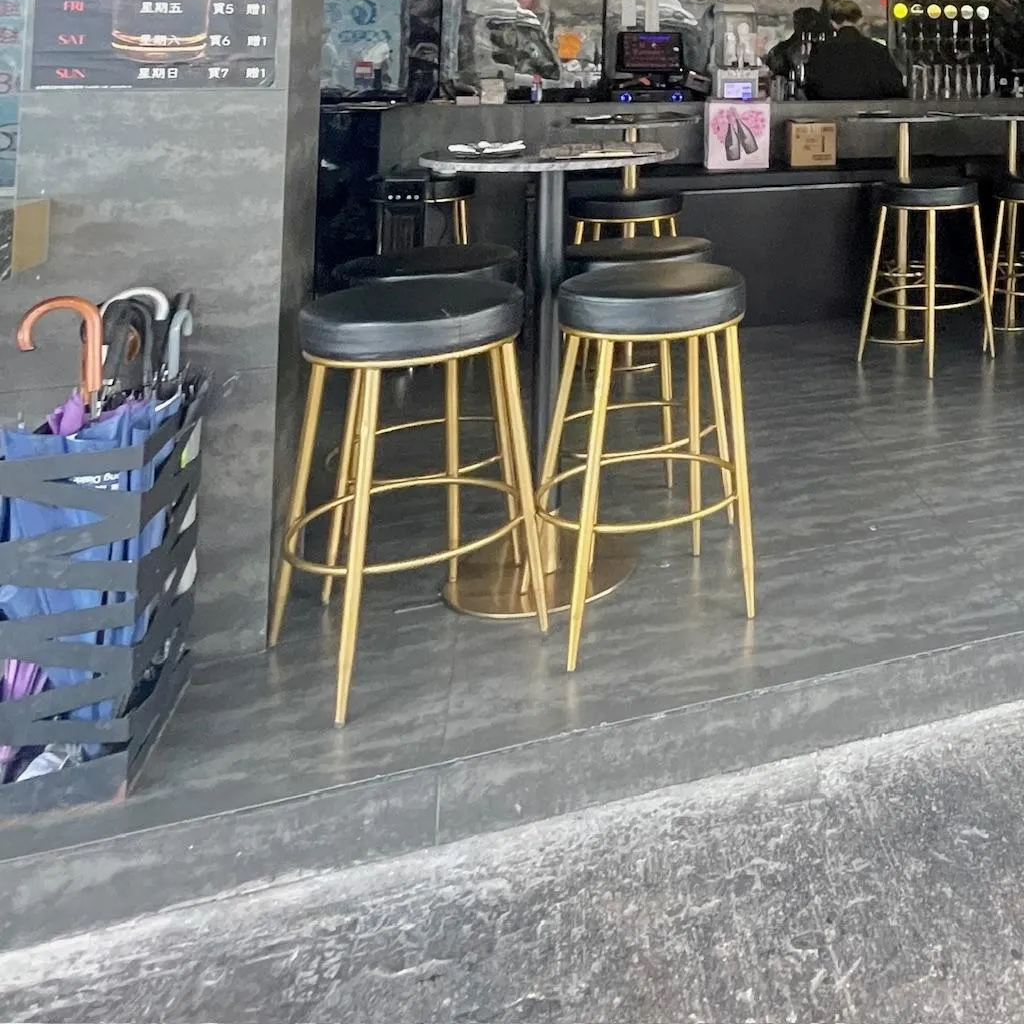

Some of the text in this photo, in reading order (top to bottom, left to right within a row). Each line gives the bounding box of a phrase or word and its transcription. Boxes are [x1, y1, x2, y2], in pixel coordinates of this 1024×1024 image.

[63, 1, 84, 12] FRI
[140, 2, 184, 14] 星期五
[213, 3, 234, 15] 買5
[58, 34, 87, 45] SAT
[139, 34, 181, 46] 星期六
[210, 35, 230, 47] 買6
[56, 68, 87, 79] SUN
[137, 68, 178, 80] 星期日
[208, 68, 229, 79] 買7
